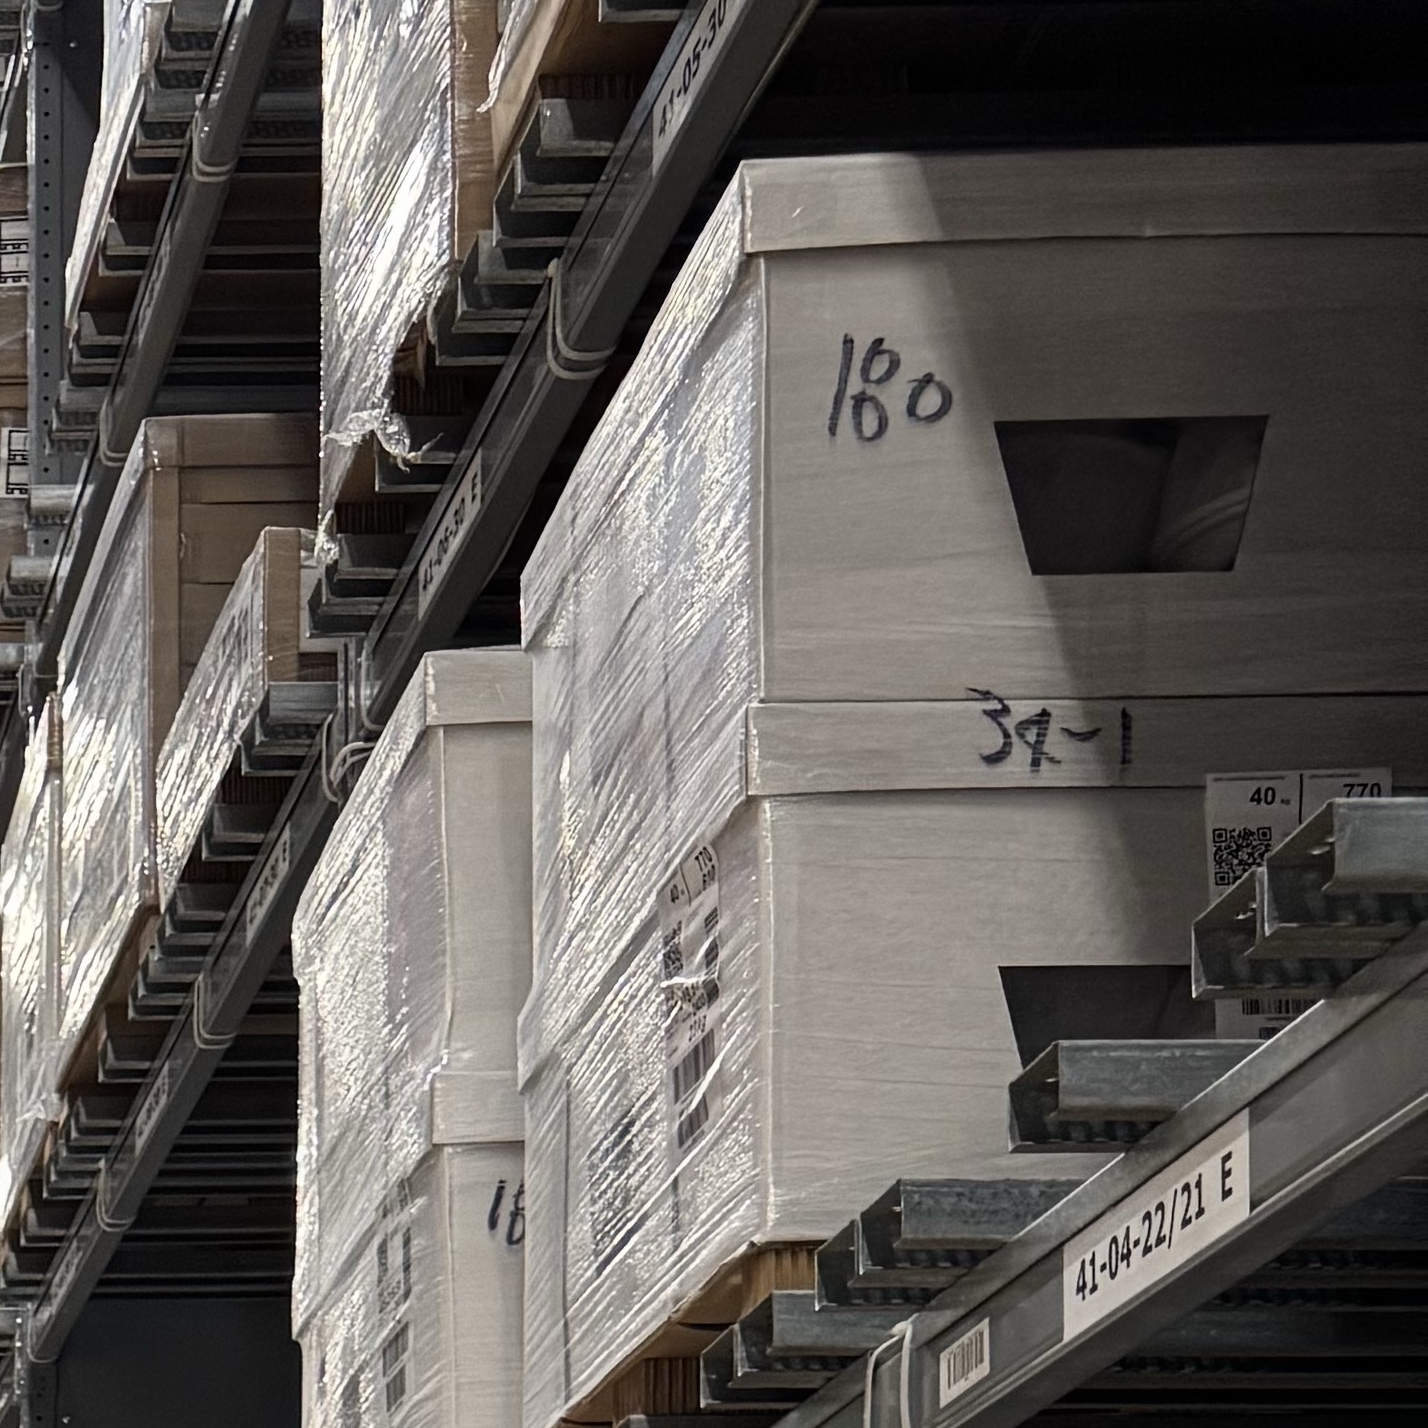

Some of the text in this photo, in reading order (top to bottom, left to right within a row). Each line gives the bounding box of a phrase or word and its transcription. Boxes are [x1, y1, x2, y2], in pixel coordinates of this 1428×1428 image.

[1249, 786, 1276, 806] 40
[1075, 1150, 1234, 1301] 41-04-22/21 E
